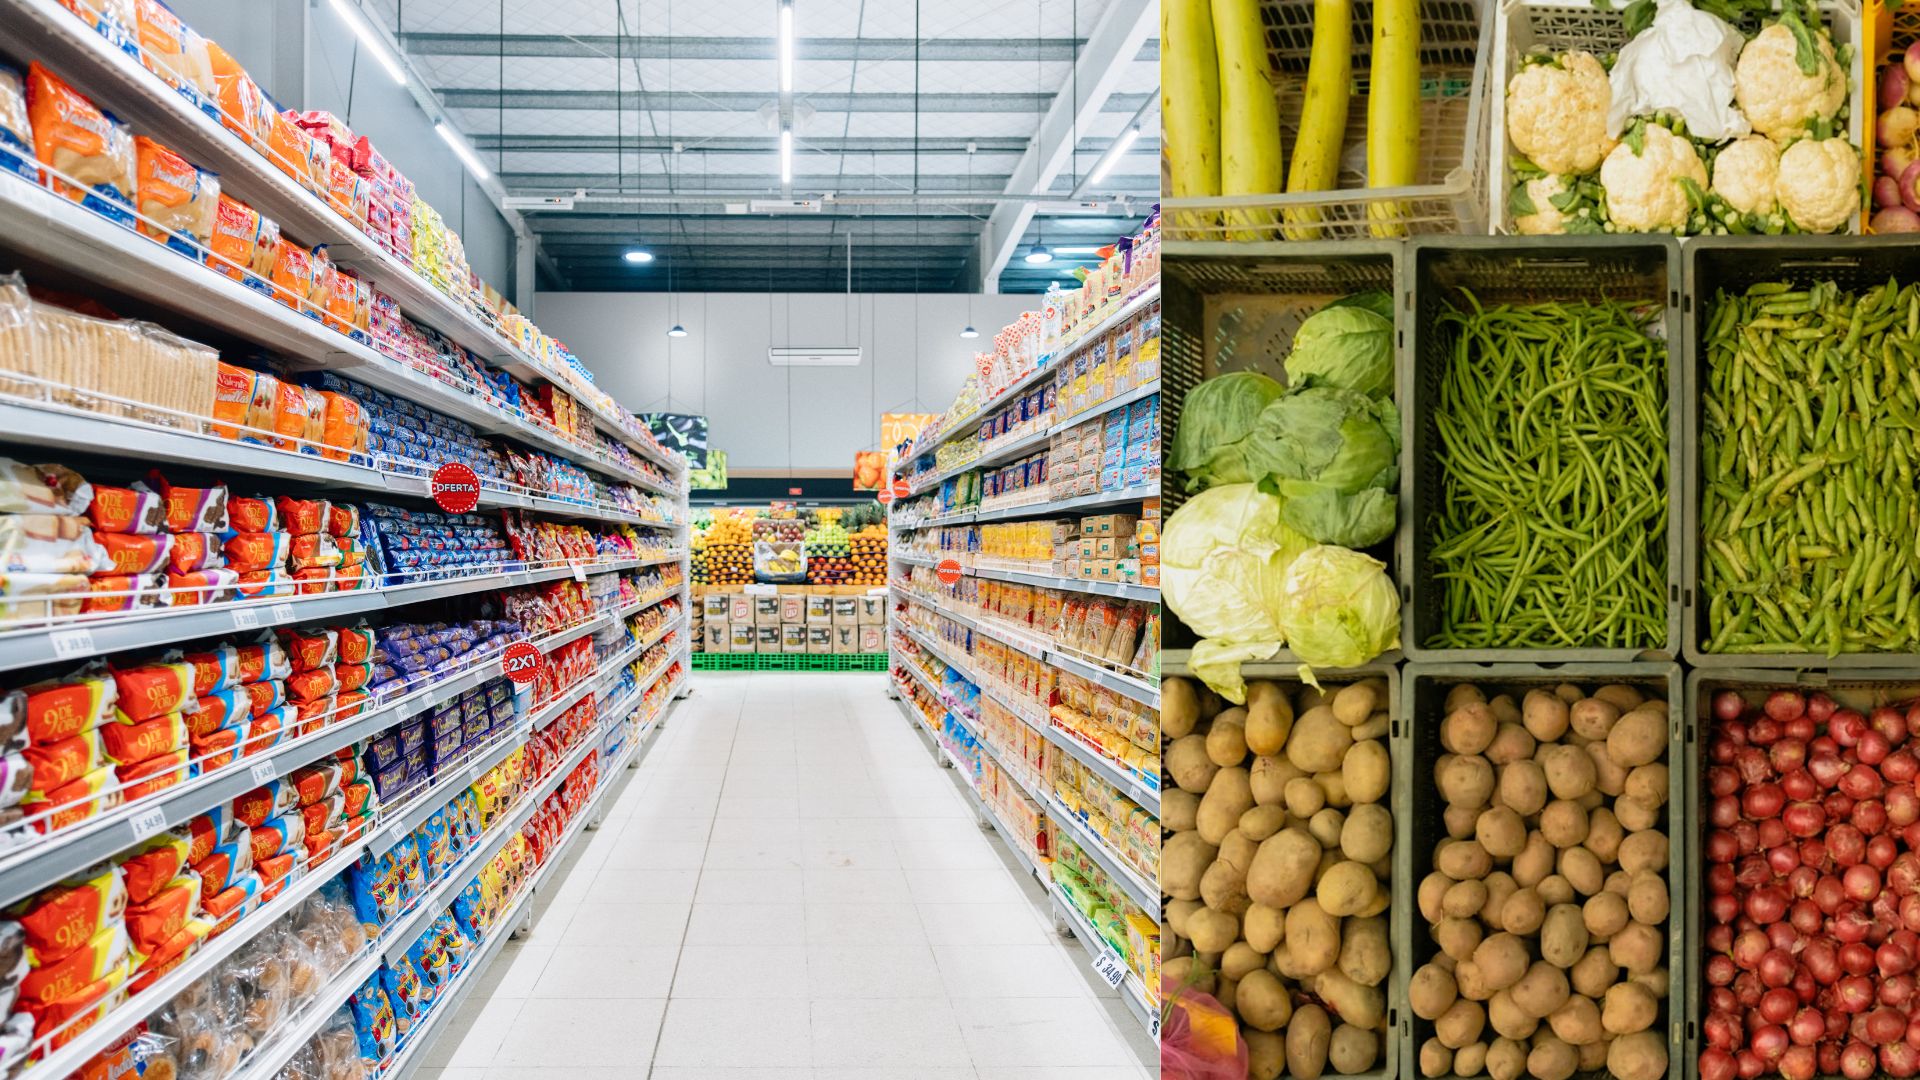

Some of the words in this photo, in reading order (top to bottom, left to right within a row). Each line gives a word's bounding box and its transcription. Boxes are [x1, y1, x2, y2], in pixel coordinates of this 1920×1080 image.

[437, 483, 476, 492] OFERTA
[97, 492, 109, 513] 9
[107, 506, 130, 521] ORO
[248, 542, 258, 560] 9
[113, 549, 126, 574] 9
[508, 653, 537, 672] 2X1
[146, 687, 158, 709] 9
[156, 684, 169, 697] DE
[155, 695, 177, 709] ORO
[44, 709, 58, 736] 9
[57, 703, 73, 717] DE
[57, 715, 83, 733] ORO
[137, 732, 152, 757] 9
[150, 728, 162, 741] DE
[55, 925, 72, 948] 9
[70, 914, 86, 929] DE
[1095, 956, 1107, 968] $
[1101, 963, 1122, 986] 34.99
[40, 983, 56, 1003] 9
